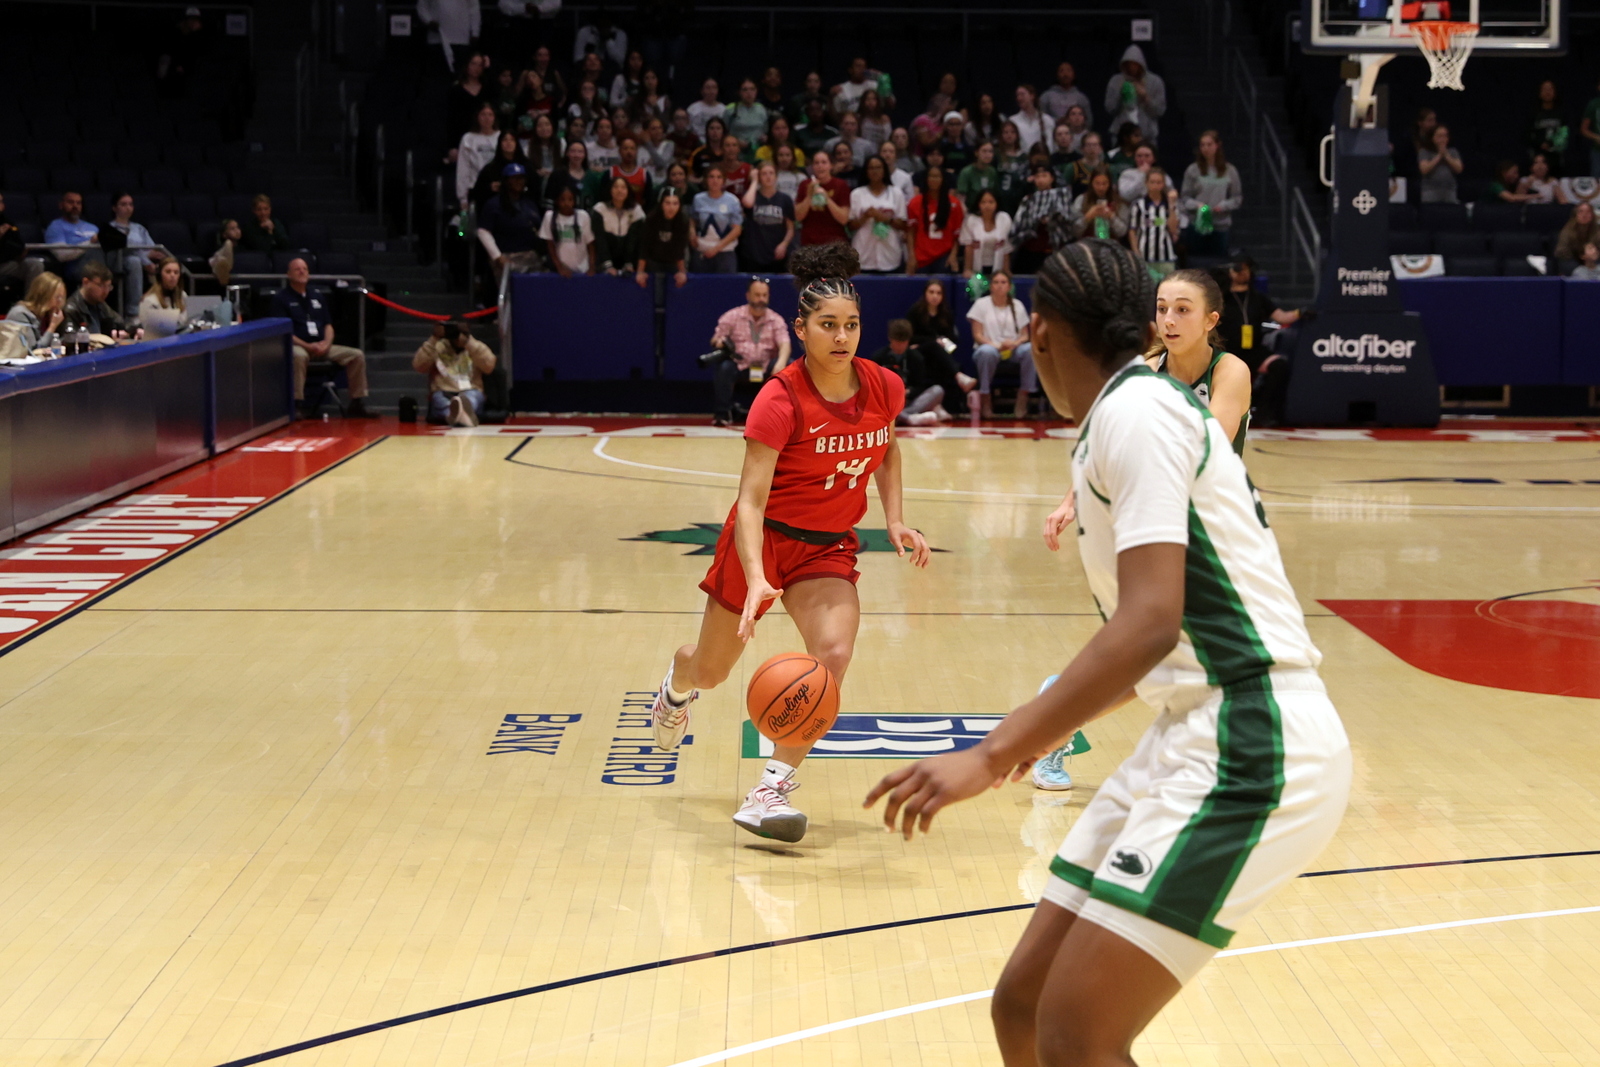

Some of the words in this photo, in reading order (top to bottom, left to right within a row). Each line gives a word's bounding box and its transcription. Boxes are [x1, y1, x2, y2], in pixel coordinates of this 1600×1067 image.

[1338, 267, 1391, 281] Premier
[1341, 282, 1387, 296] Health
[1313, 334, 1416, 362] altafiber
[815, 426, 889, 453] BELLEVUE
[824, 457, 872, 490] 14
[0, 494, 267, 560] COURT
[768, 684, 809, 733] Rawlings
[485, 713, 582, 755] BANK
